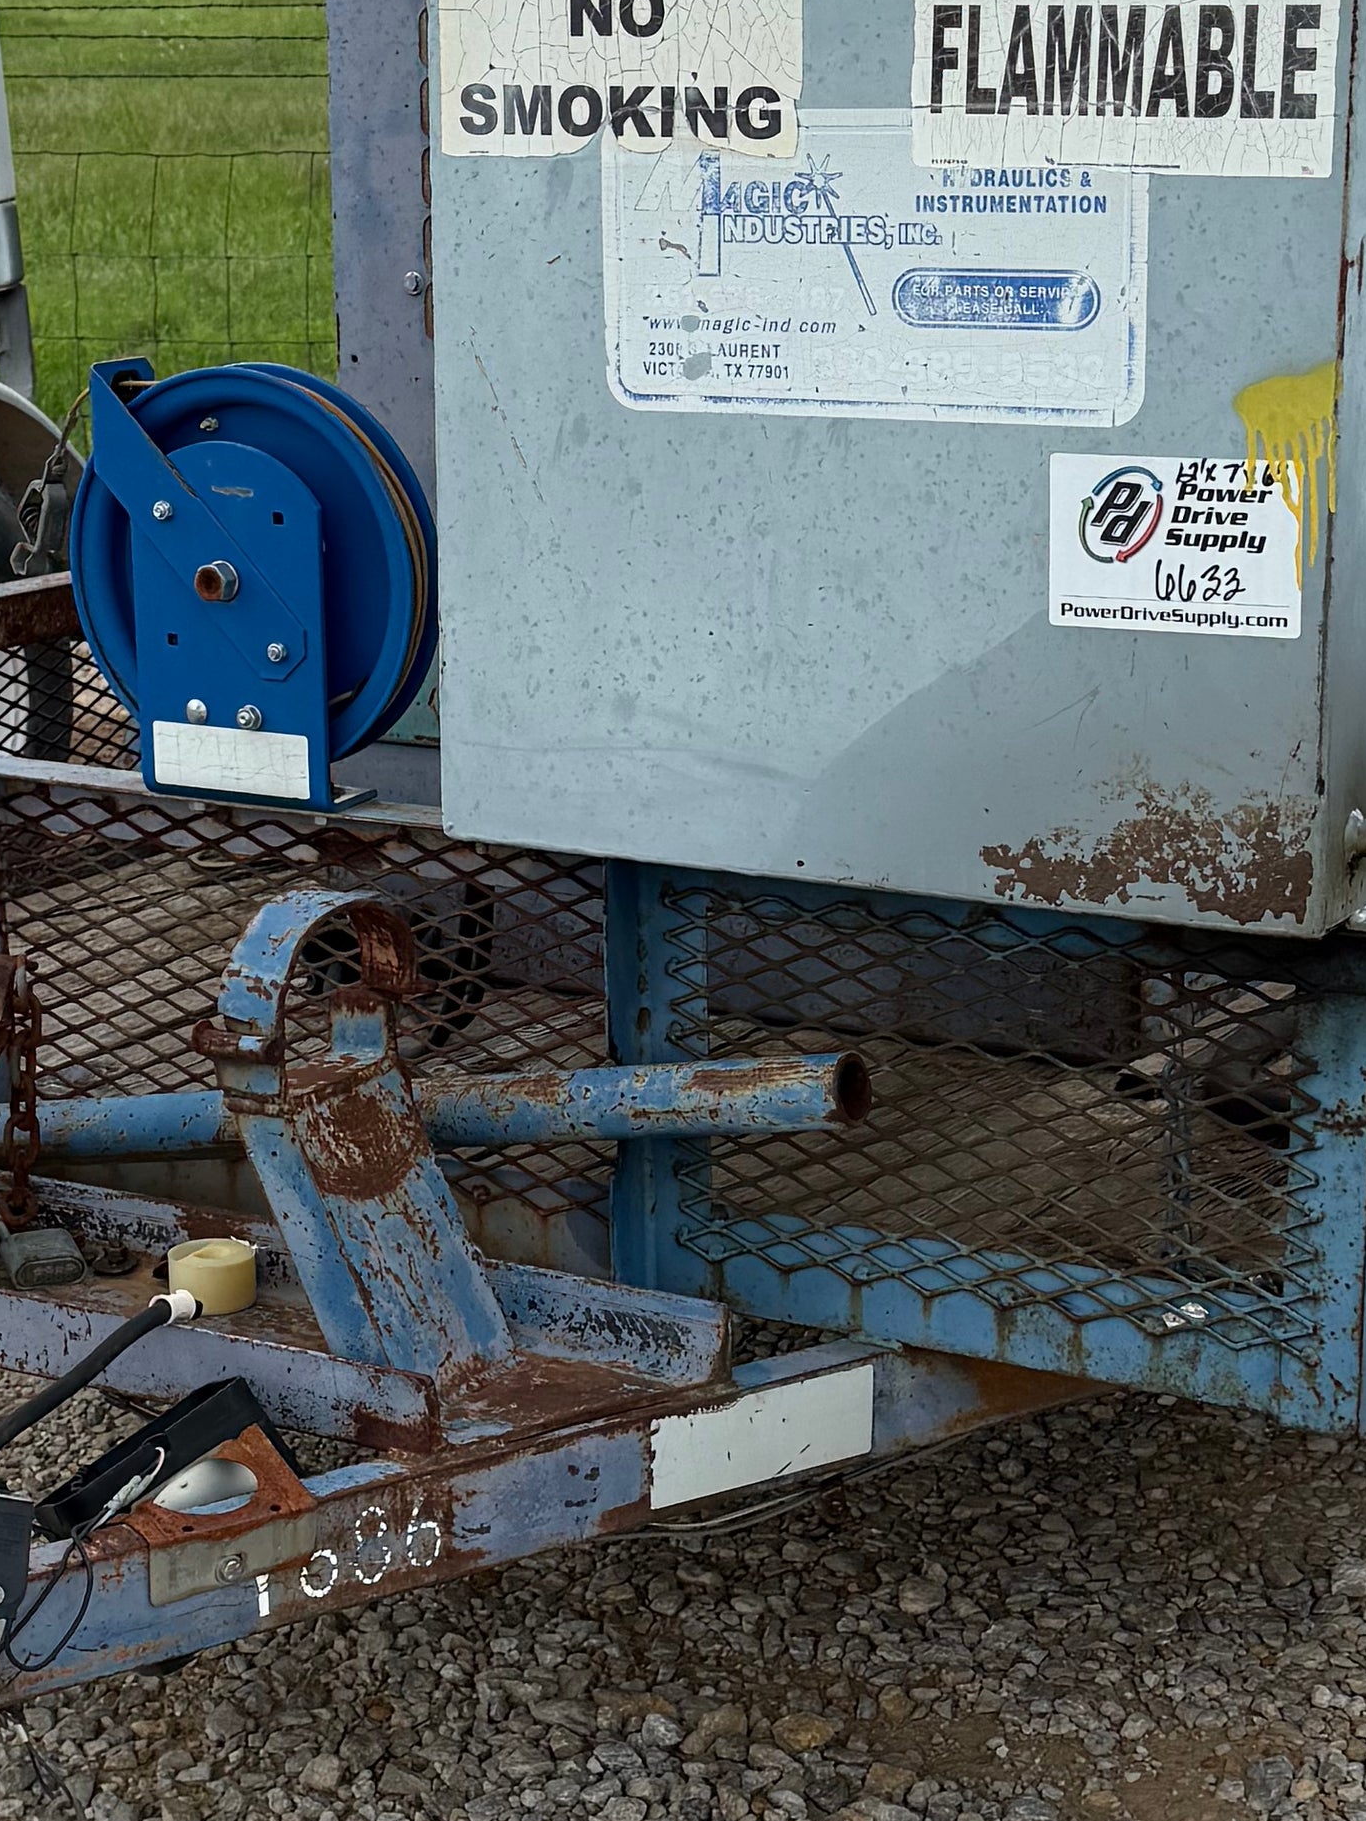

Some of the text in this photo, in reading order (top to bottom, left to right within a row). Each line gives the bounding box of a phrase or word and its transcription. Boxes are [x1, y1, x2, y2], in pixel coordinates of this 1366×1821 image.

[930, 4, 1322, 120] FLAMMABLE
[459, 83, 782, 140] SMOKING
[942, 168, 1092, 188] HDRAULICS &
[915, 194, 1107, 214] INSTRUMENTATION
[898, 223, 942, 246] INC.
[945, 286, 989, 298] PARTS
[711, 343, 781, 358] AURENT
[724, 364, 743, 378] TX
[748, 365, 789, 379] 77901
[1177, 483, 1273, 504] Power
[1171, 506, 1248, 526] Drive
[1164, 528, 1267, 554] Supply
[1060, 602, 1288, 628] PowerDriveSupply.com
